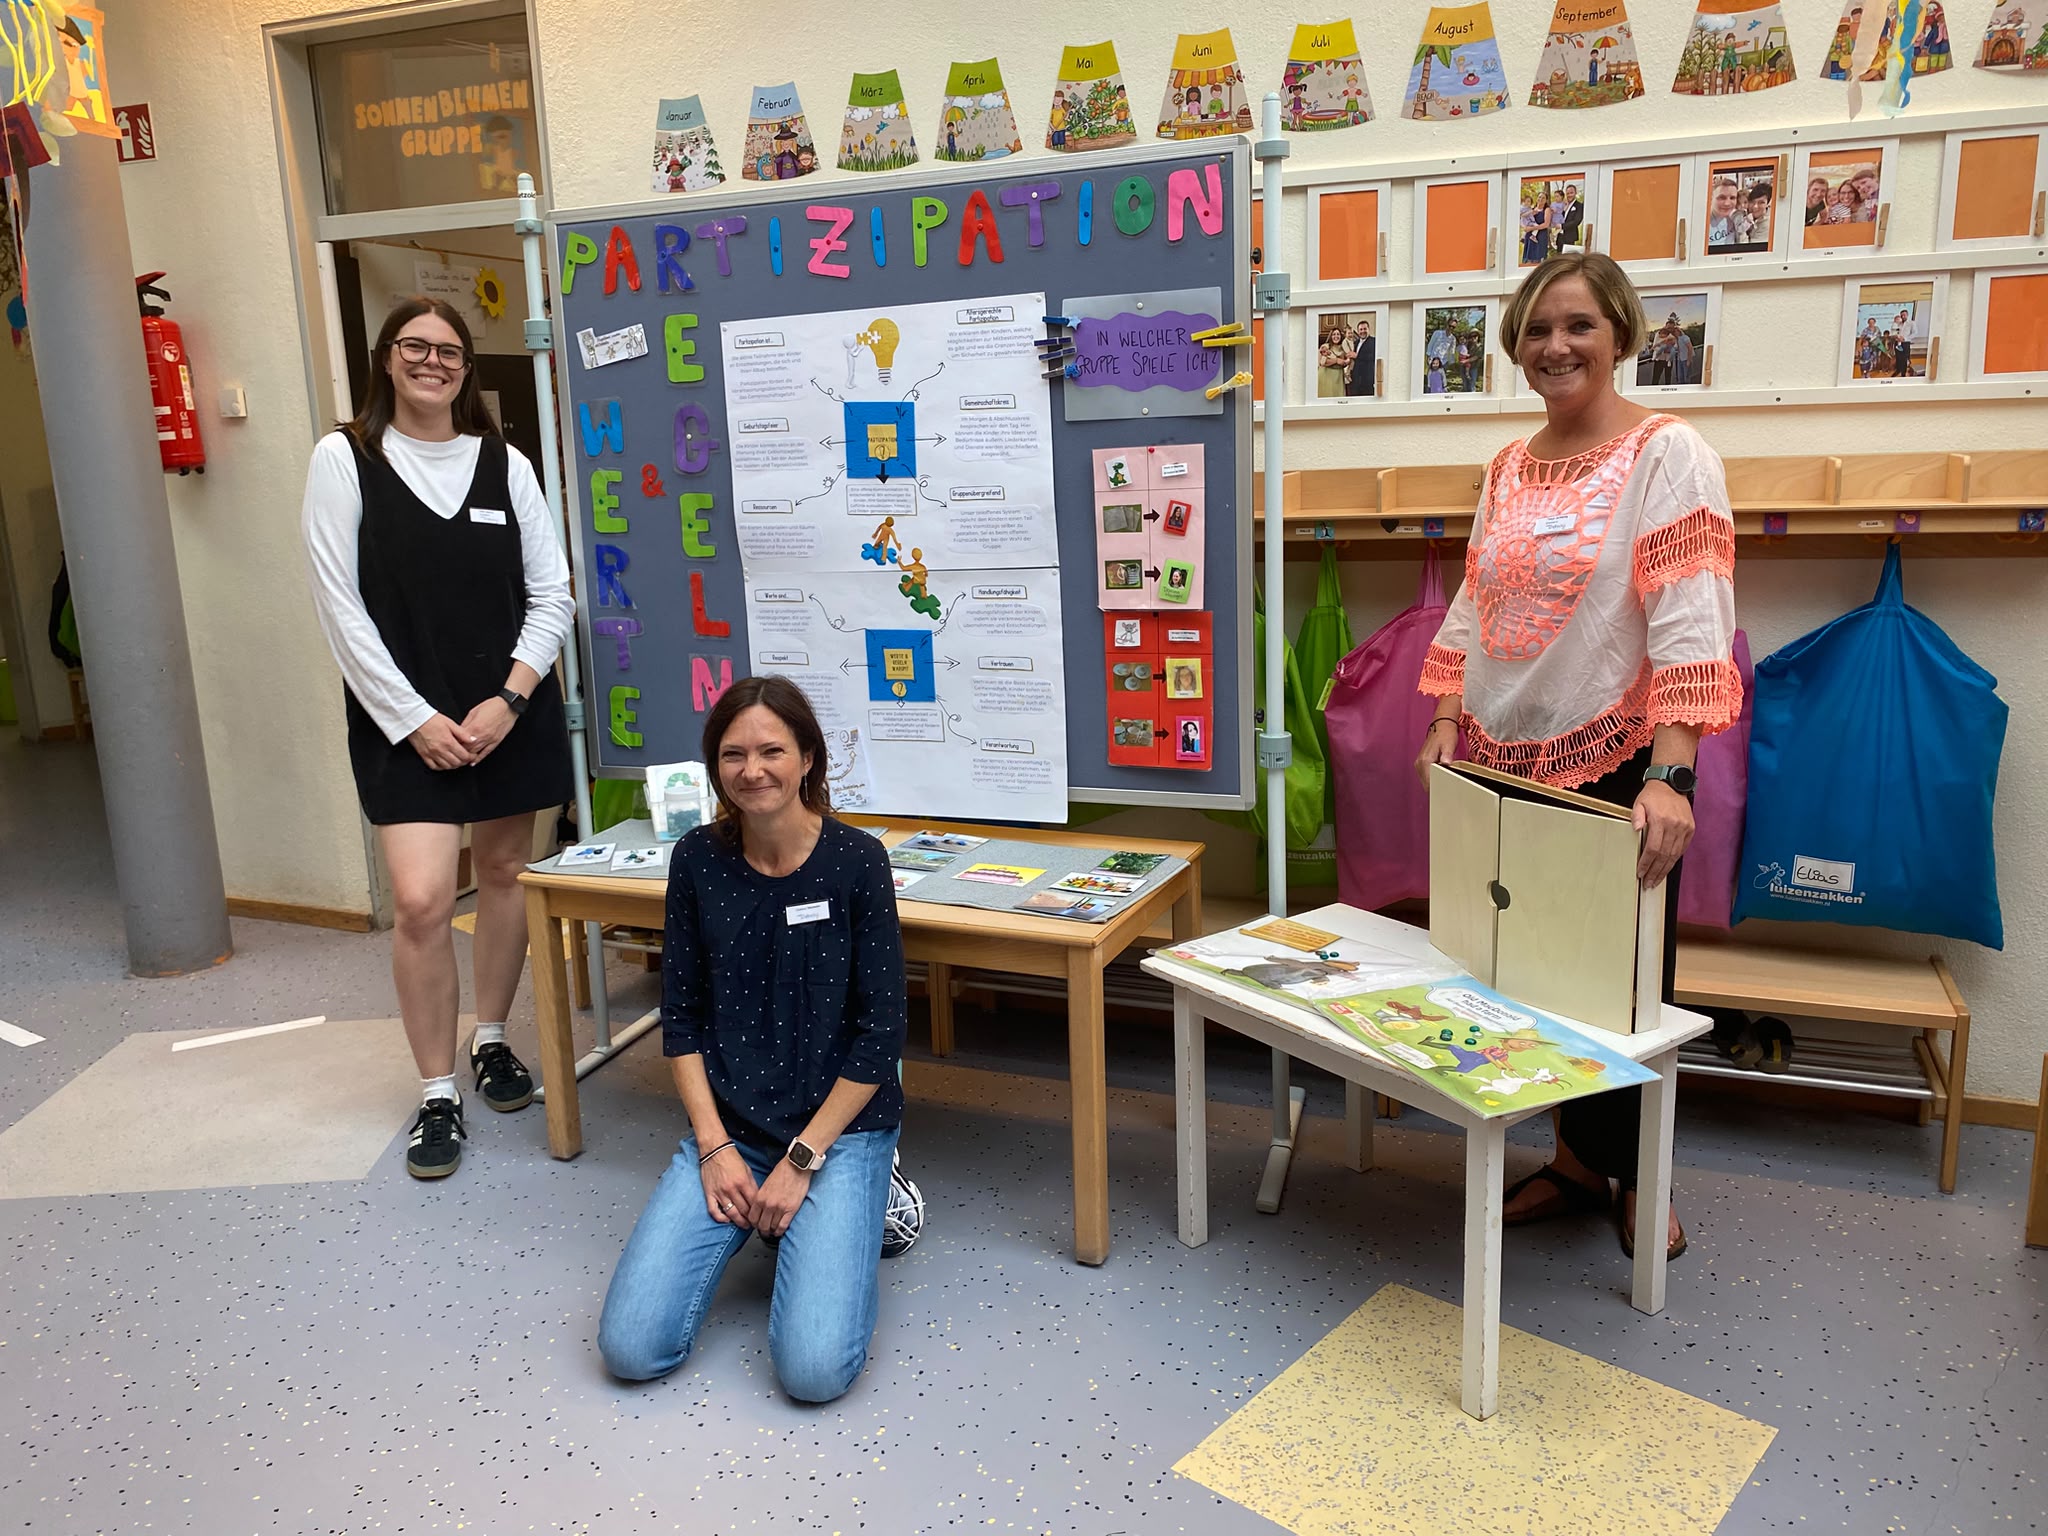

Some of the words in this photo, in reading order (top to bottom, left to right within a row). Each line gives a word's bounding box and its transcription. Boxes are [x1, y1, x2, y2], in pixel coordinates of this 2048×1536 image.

[1555, 5, 1617, 25] September
[1434, 21, 1475, 39] August
[1191, 45, 1212, 57] Juni
[1310, 34, 1330, 48] Juli
[1076, 57, 1093, 69] Mai
[962, 73, 985, 88] April
[860, 86, 884, 98] März
[354, 79, 529, 129] SONNENBLUMEN
[757, 95, 792, 110] Februar
[665, 110, 692, 123] Januar
[401, 125, 482, 157] GRUPPE
[561, 163, 1223, 295] PARTIZIPATION
[1096, 330, 1109, 347] IN
[1118, 327, 1187, 348] WELCHER
[1075, 354, 1120, 377] GRUPPE
[1132, 353, 1175, 377] SPIELE
[1186, 350, 1218, 371] ICH?
[641, 464, 666, 497] &
[579, 401, 643, 747] WERTE
[1796, 865, 1840, 885] Elias
[1769, 882, 1863, 904] luizenzakken
